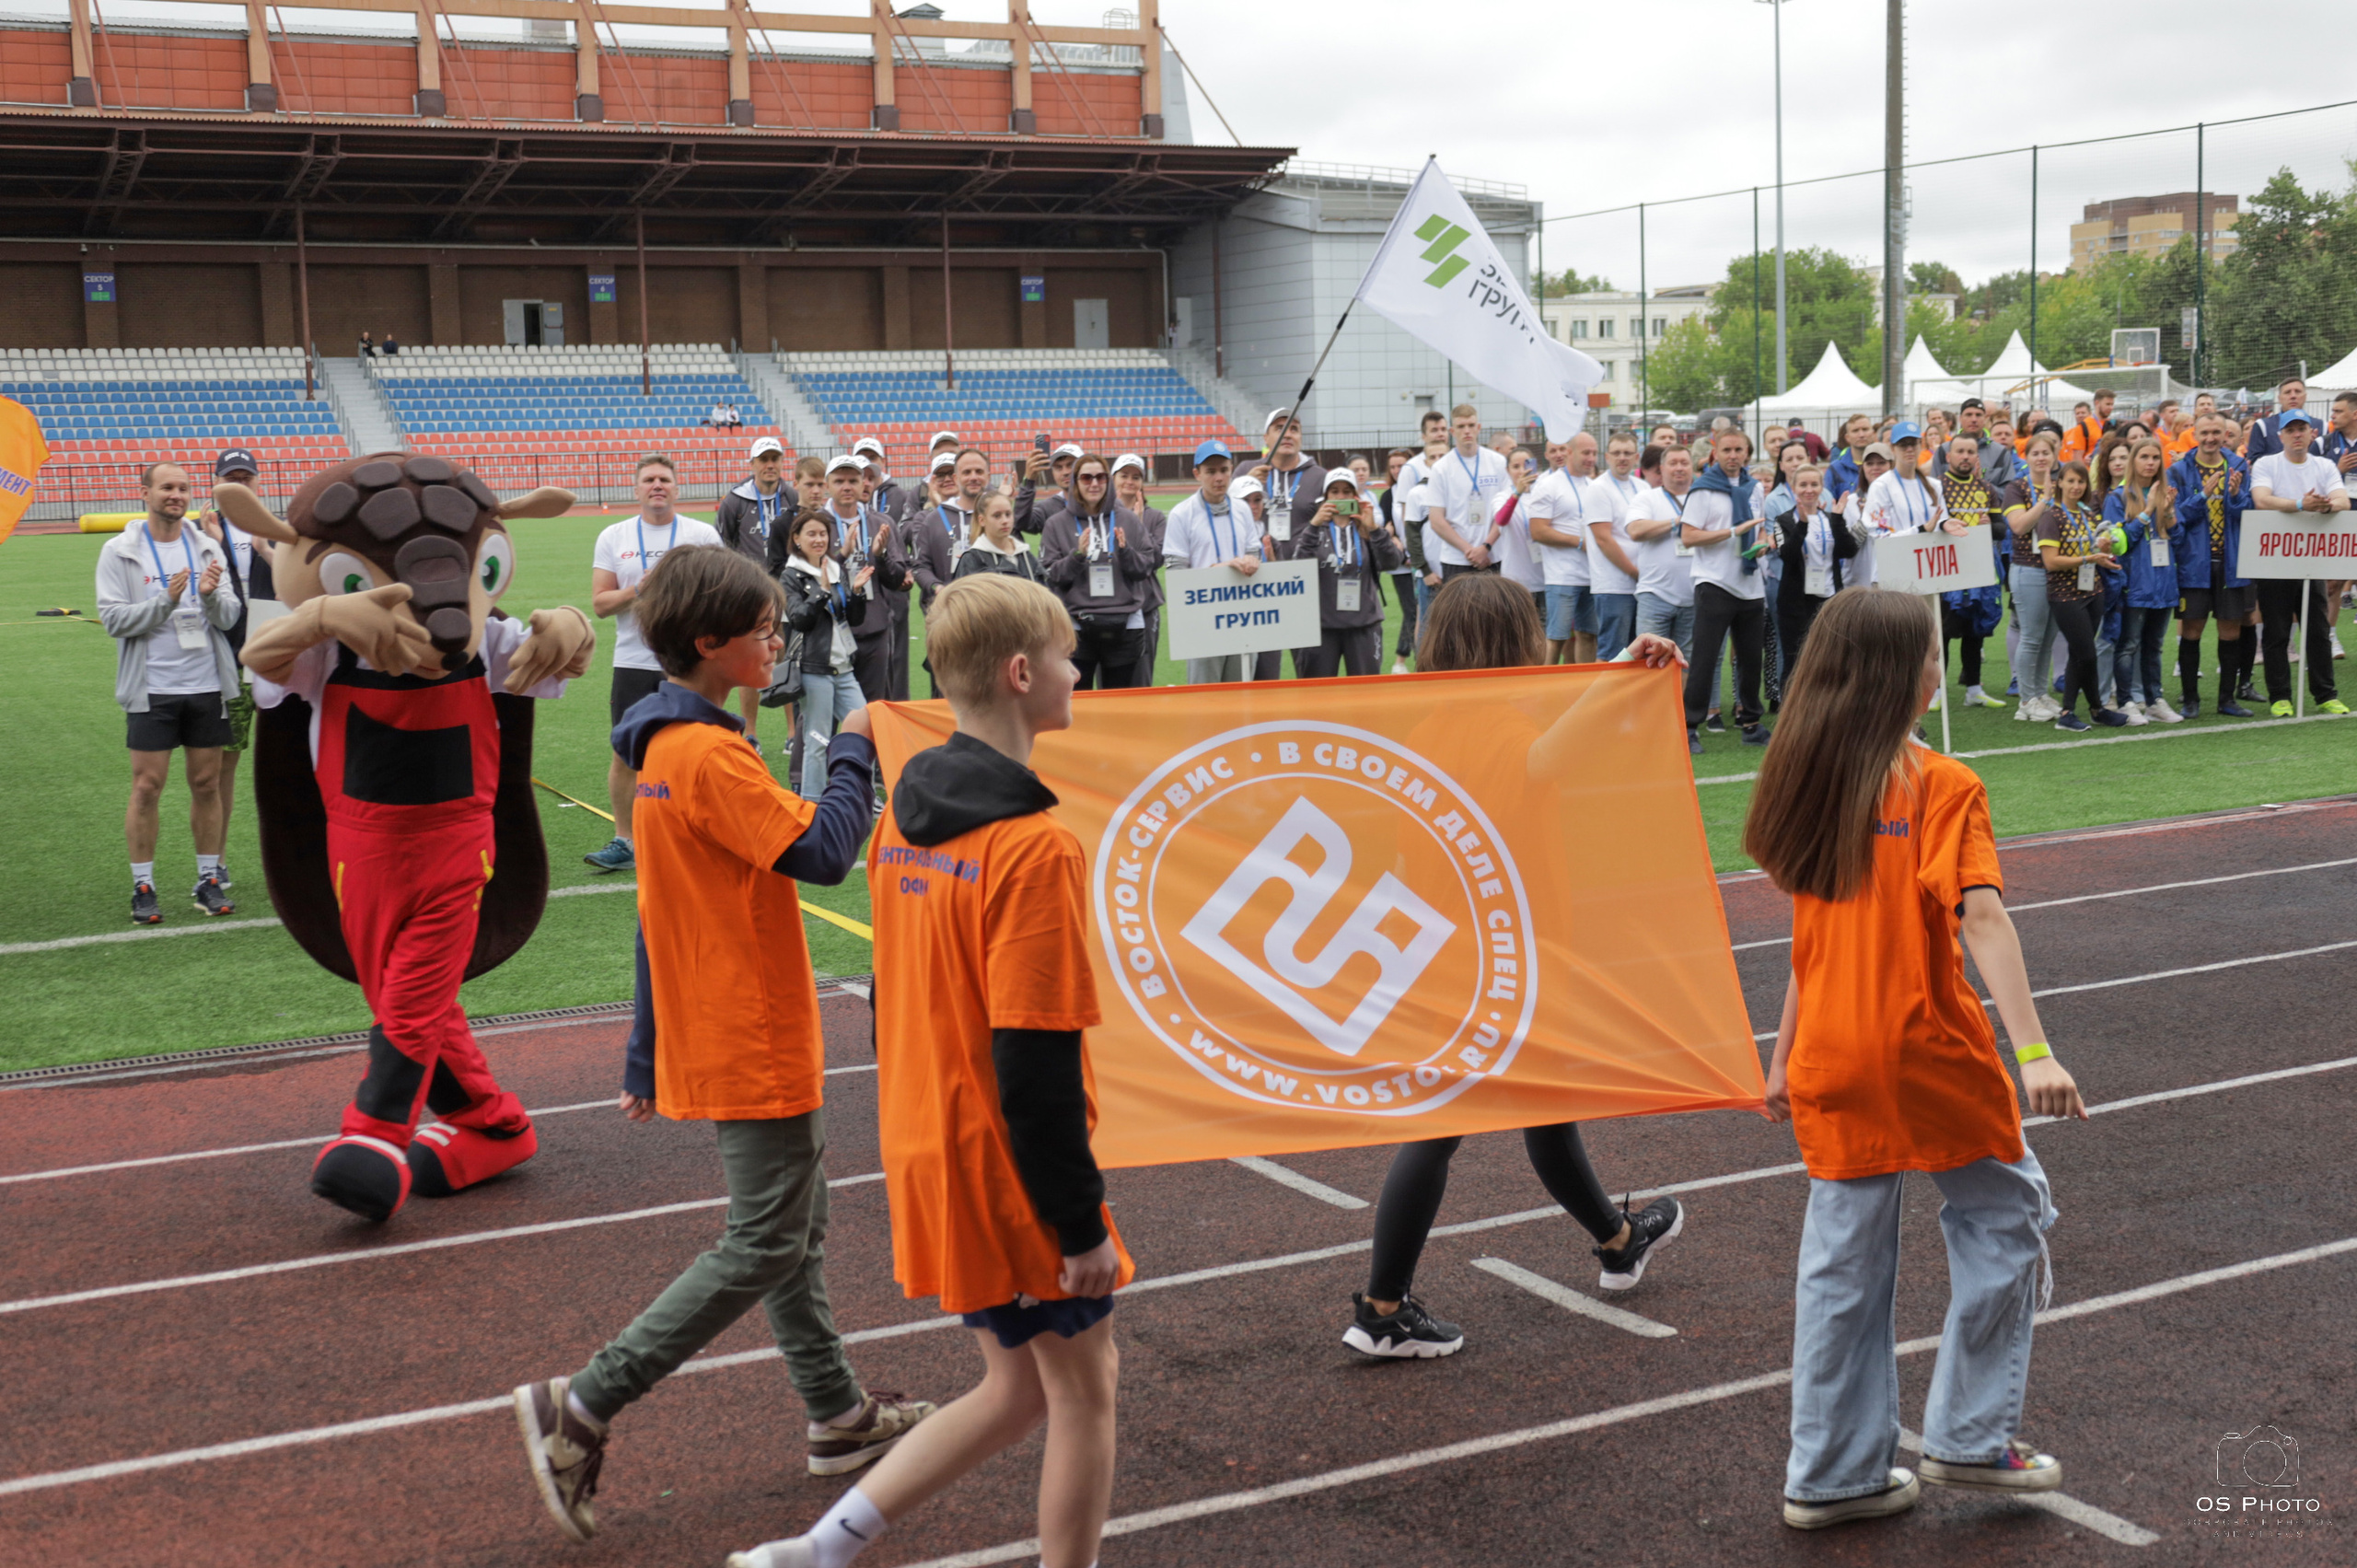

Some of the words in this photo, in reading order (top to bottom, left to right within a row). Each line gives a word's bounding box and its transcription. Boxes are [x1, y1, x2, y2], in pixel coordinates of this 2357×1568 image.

[1468, 279, 1535, 344] ГРУ
[1913, 543, 1959, 579] ТУЛА
[1184, 575, 1305, 605] ЗЕЛИНСКИЙ
[1214, 609, 1280, 630] ГРУПП
[1114, 757, 1234, 999] ВОСТОК-СЕРВИС
[1278, 741, 1301, 764] В
[1313, 742, 1437, 811] СВОЕМ
[1433, 809, 1504, 899] ДЕЛЕ
[1487, 909, 1517, 1002] СПЕЦ
[1190, 1022, 1501, 1105] WWW.VOSTO.RU
